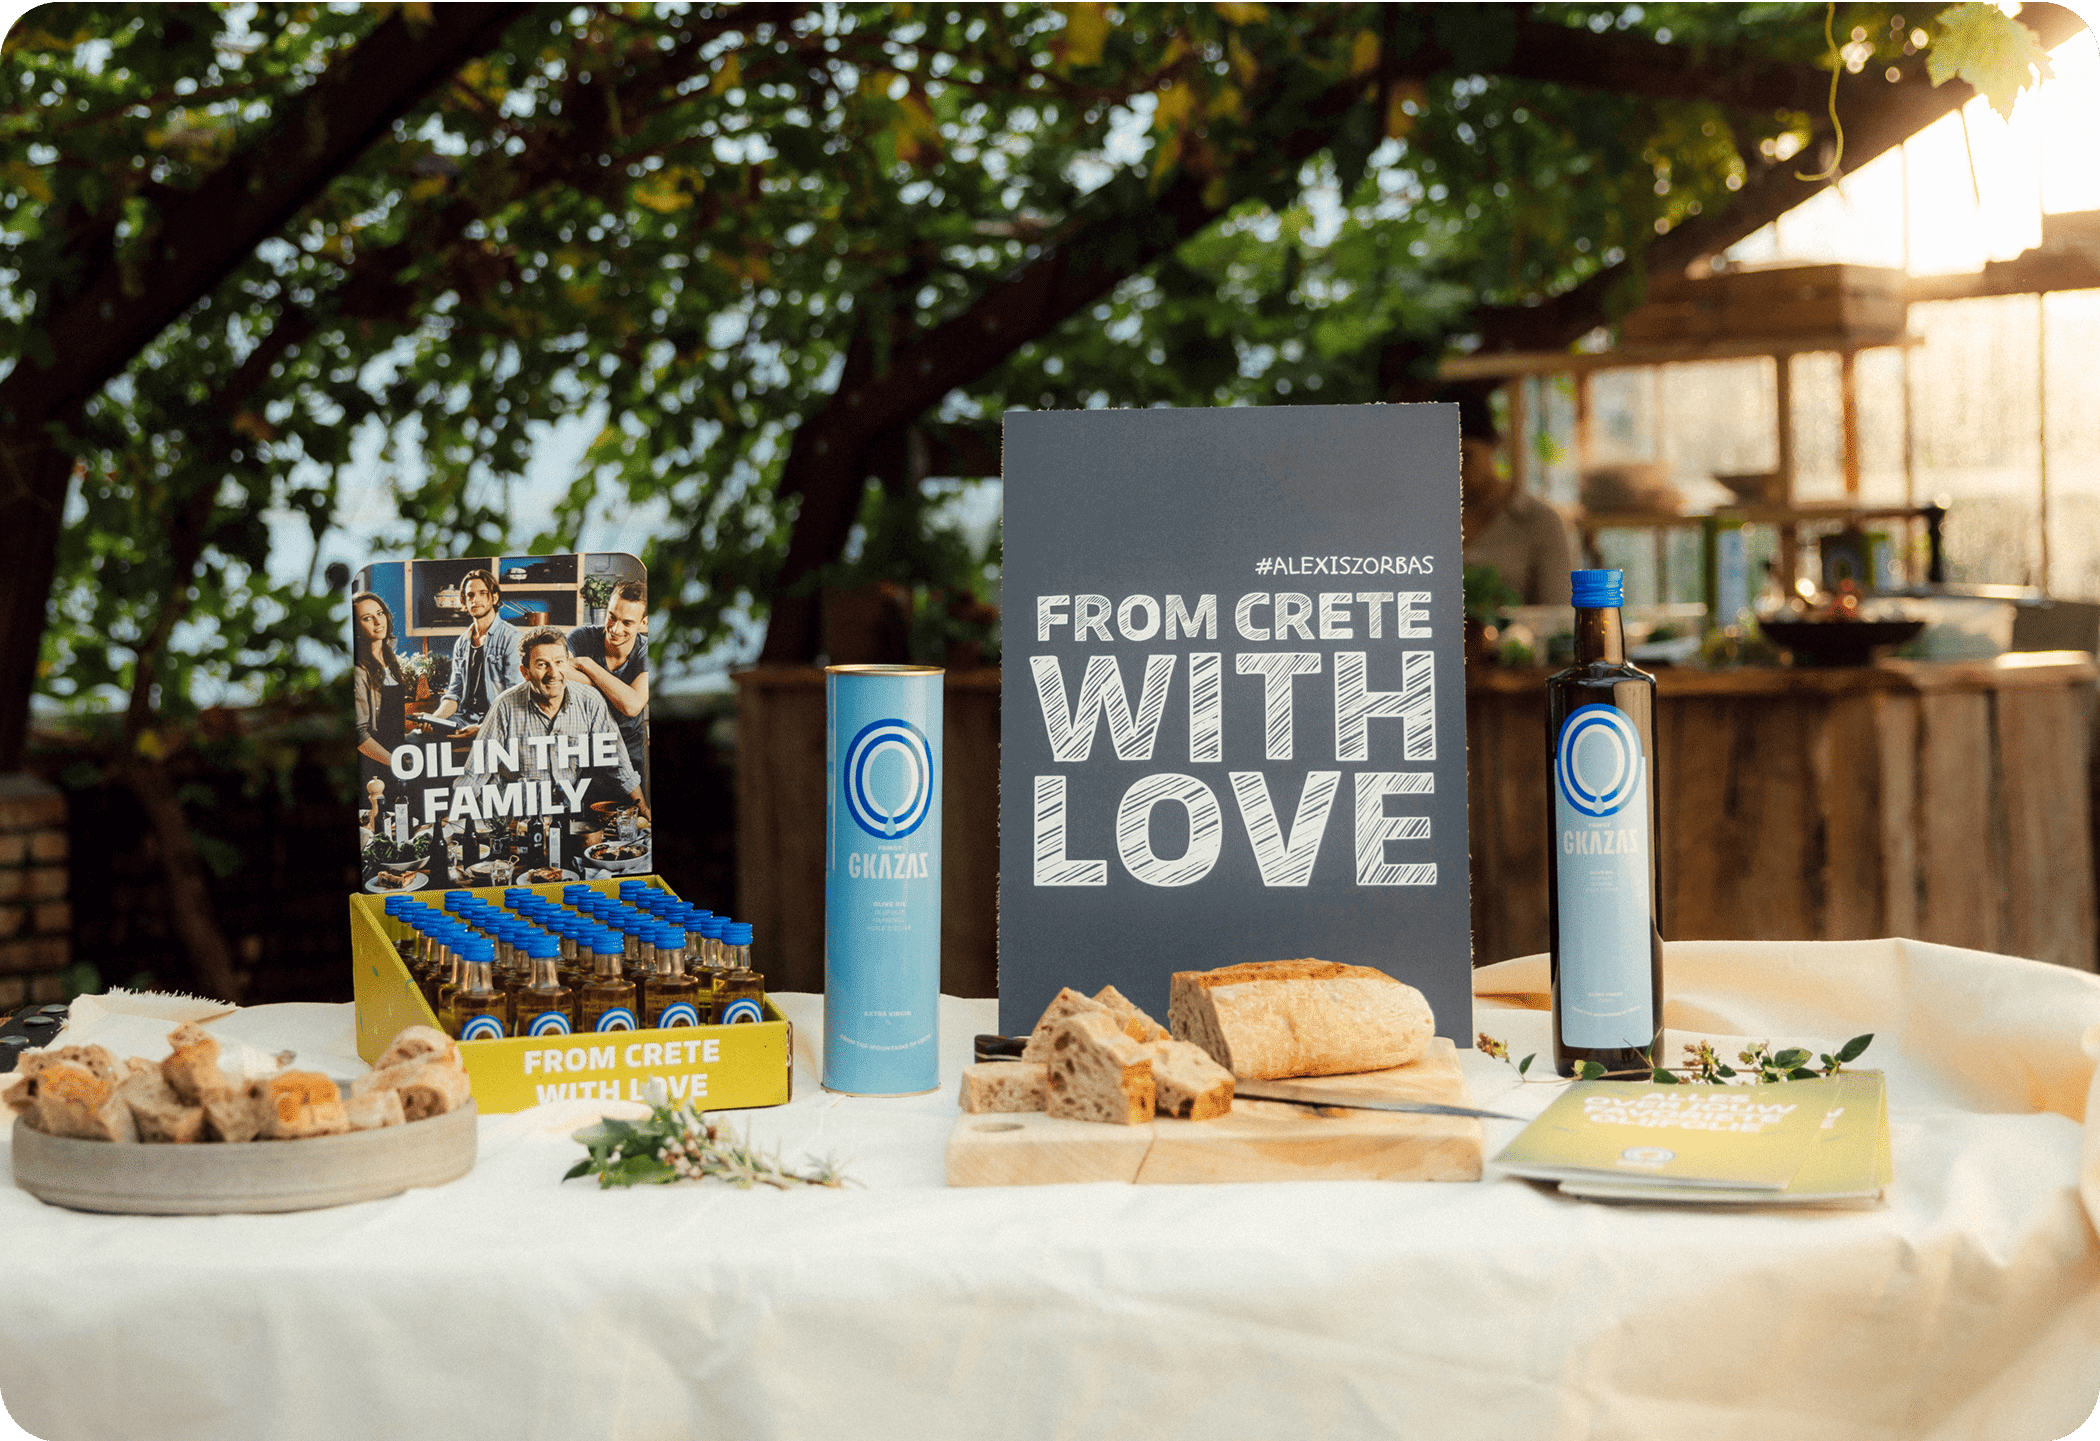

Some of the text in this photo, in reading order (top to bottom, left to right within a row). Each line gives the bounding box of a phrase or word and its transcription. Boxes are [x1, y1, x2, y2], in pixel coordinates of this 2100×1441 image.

[1255, 556, 1434, 575] #ALEXISZORBAS
[1036, 591, 1433, 642] FROM CRETE
[1029, 650, 1437, 763] WITH
[390, 732, 619, 781] OIL IN THE
[423, 778, 592, 824] FAMILY
[1033, 770, 1438, 888] LOVE
[523, 1038, 720, 1075] FROM CRETE
[536, 1079, 620, 1105] WITH
